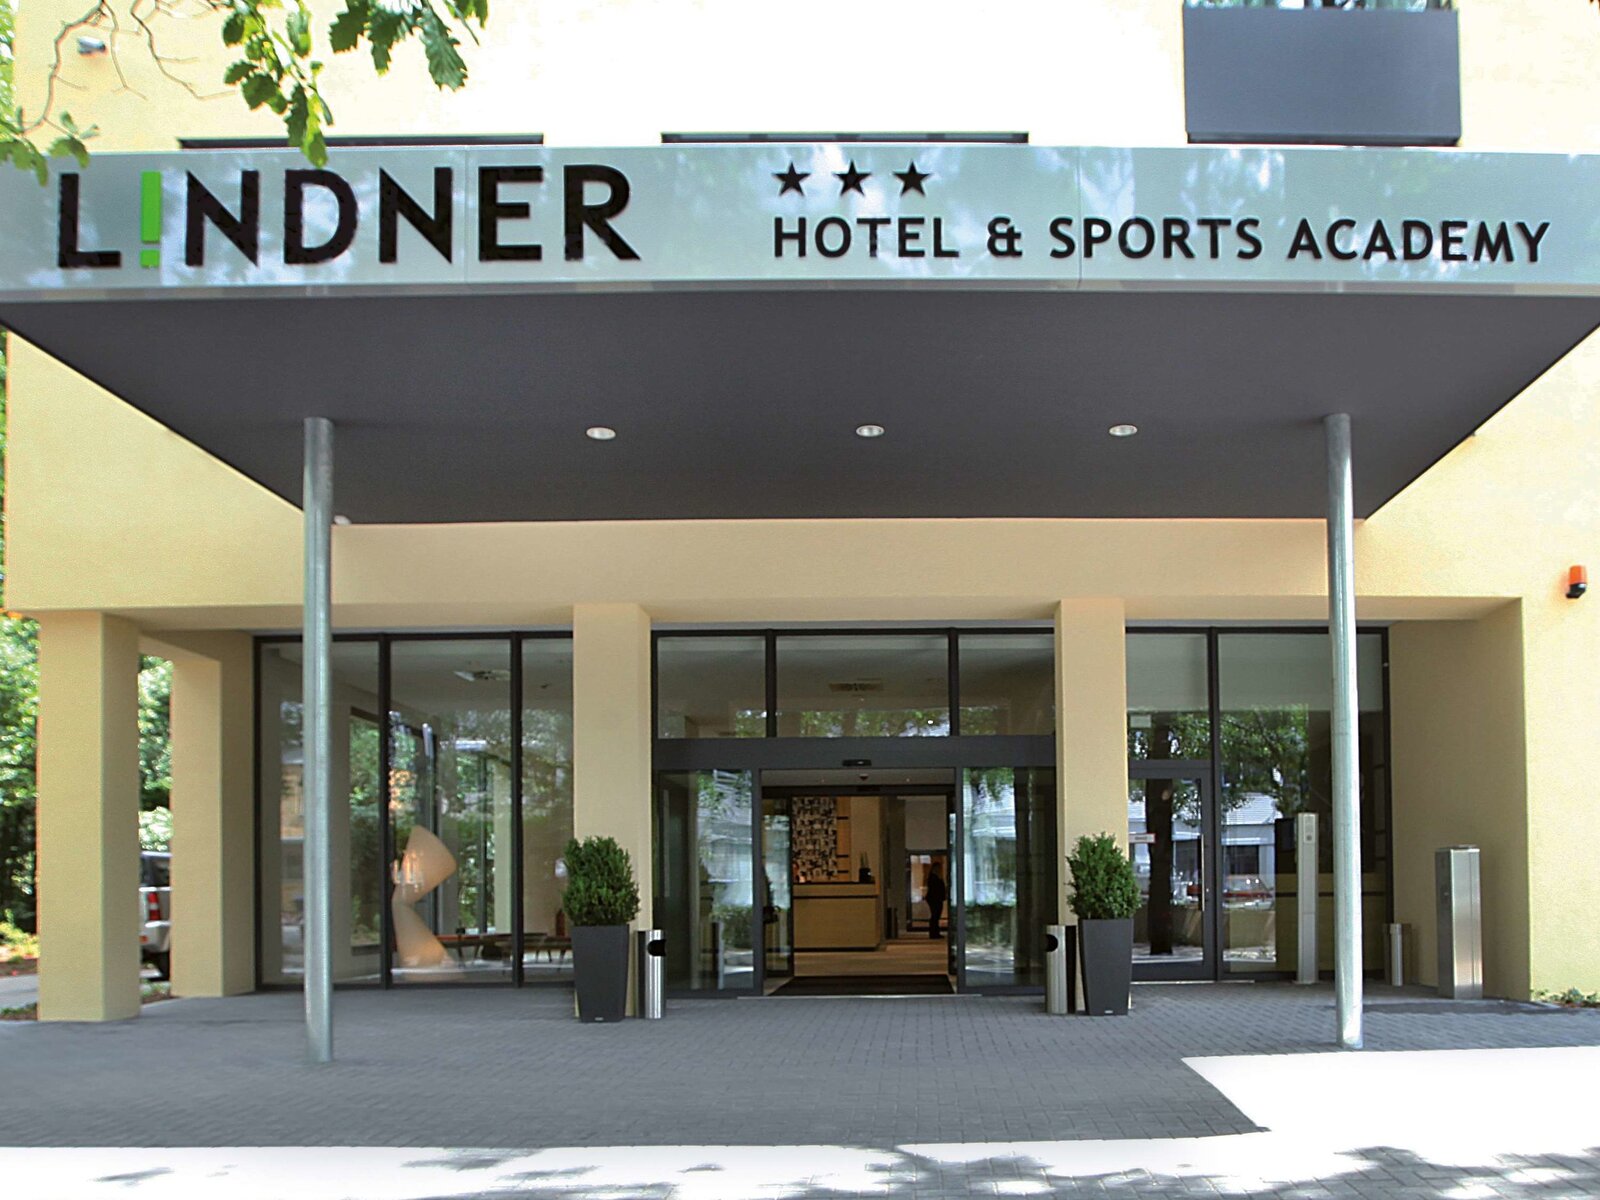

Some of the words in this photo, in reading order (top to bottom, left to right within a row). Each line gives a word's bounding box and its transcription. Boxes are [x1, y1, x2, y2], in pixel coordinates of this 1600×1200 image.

[774, 217, 960, 259] HOTEL
[987, 217, 1023, 258] &
[1049, 217, 1263, 260] SPORTS
[1287, 218, 1550, 263] ACADEMY
